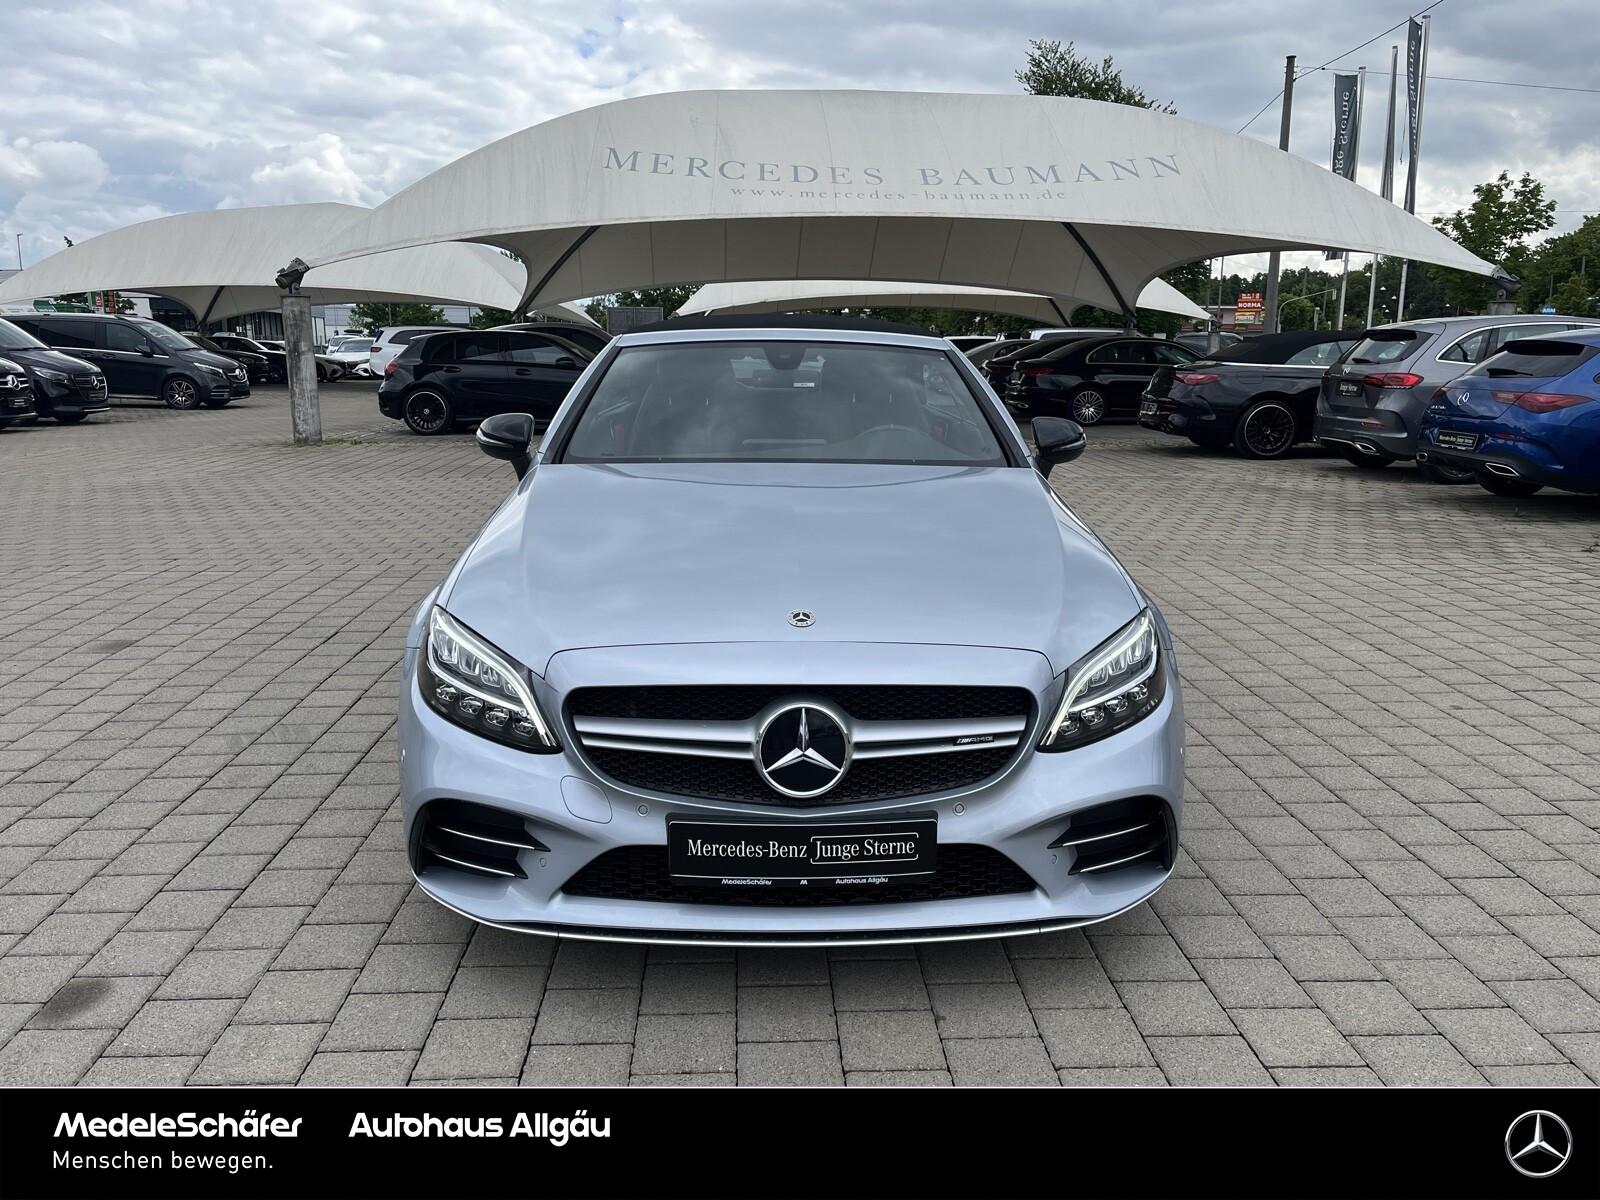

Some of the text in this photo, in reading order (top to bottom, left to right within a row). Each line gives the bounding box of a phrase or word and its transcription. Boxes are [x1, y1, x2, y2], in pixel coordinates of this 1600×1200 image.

[603, 147, 1182, 187] MERCEDES BAUMANN
[730, 187, 1066, 201] www.mercedes-baumann.de
[687, 838, 916, 860] Mercedes-Benz Junge Sterne
[721, 878, 773, 886] MedeleSchäfer
[835, 876, 889, 885] Autohaus Allgäu
